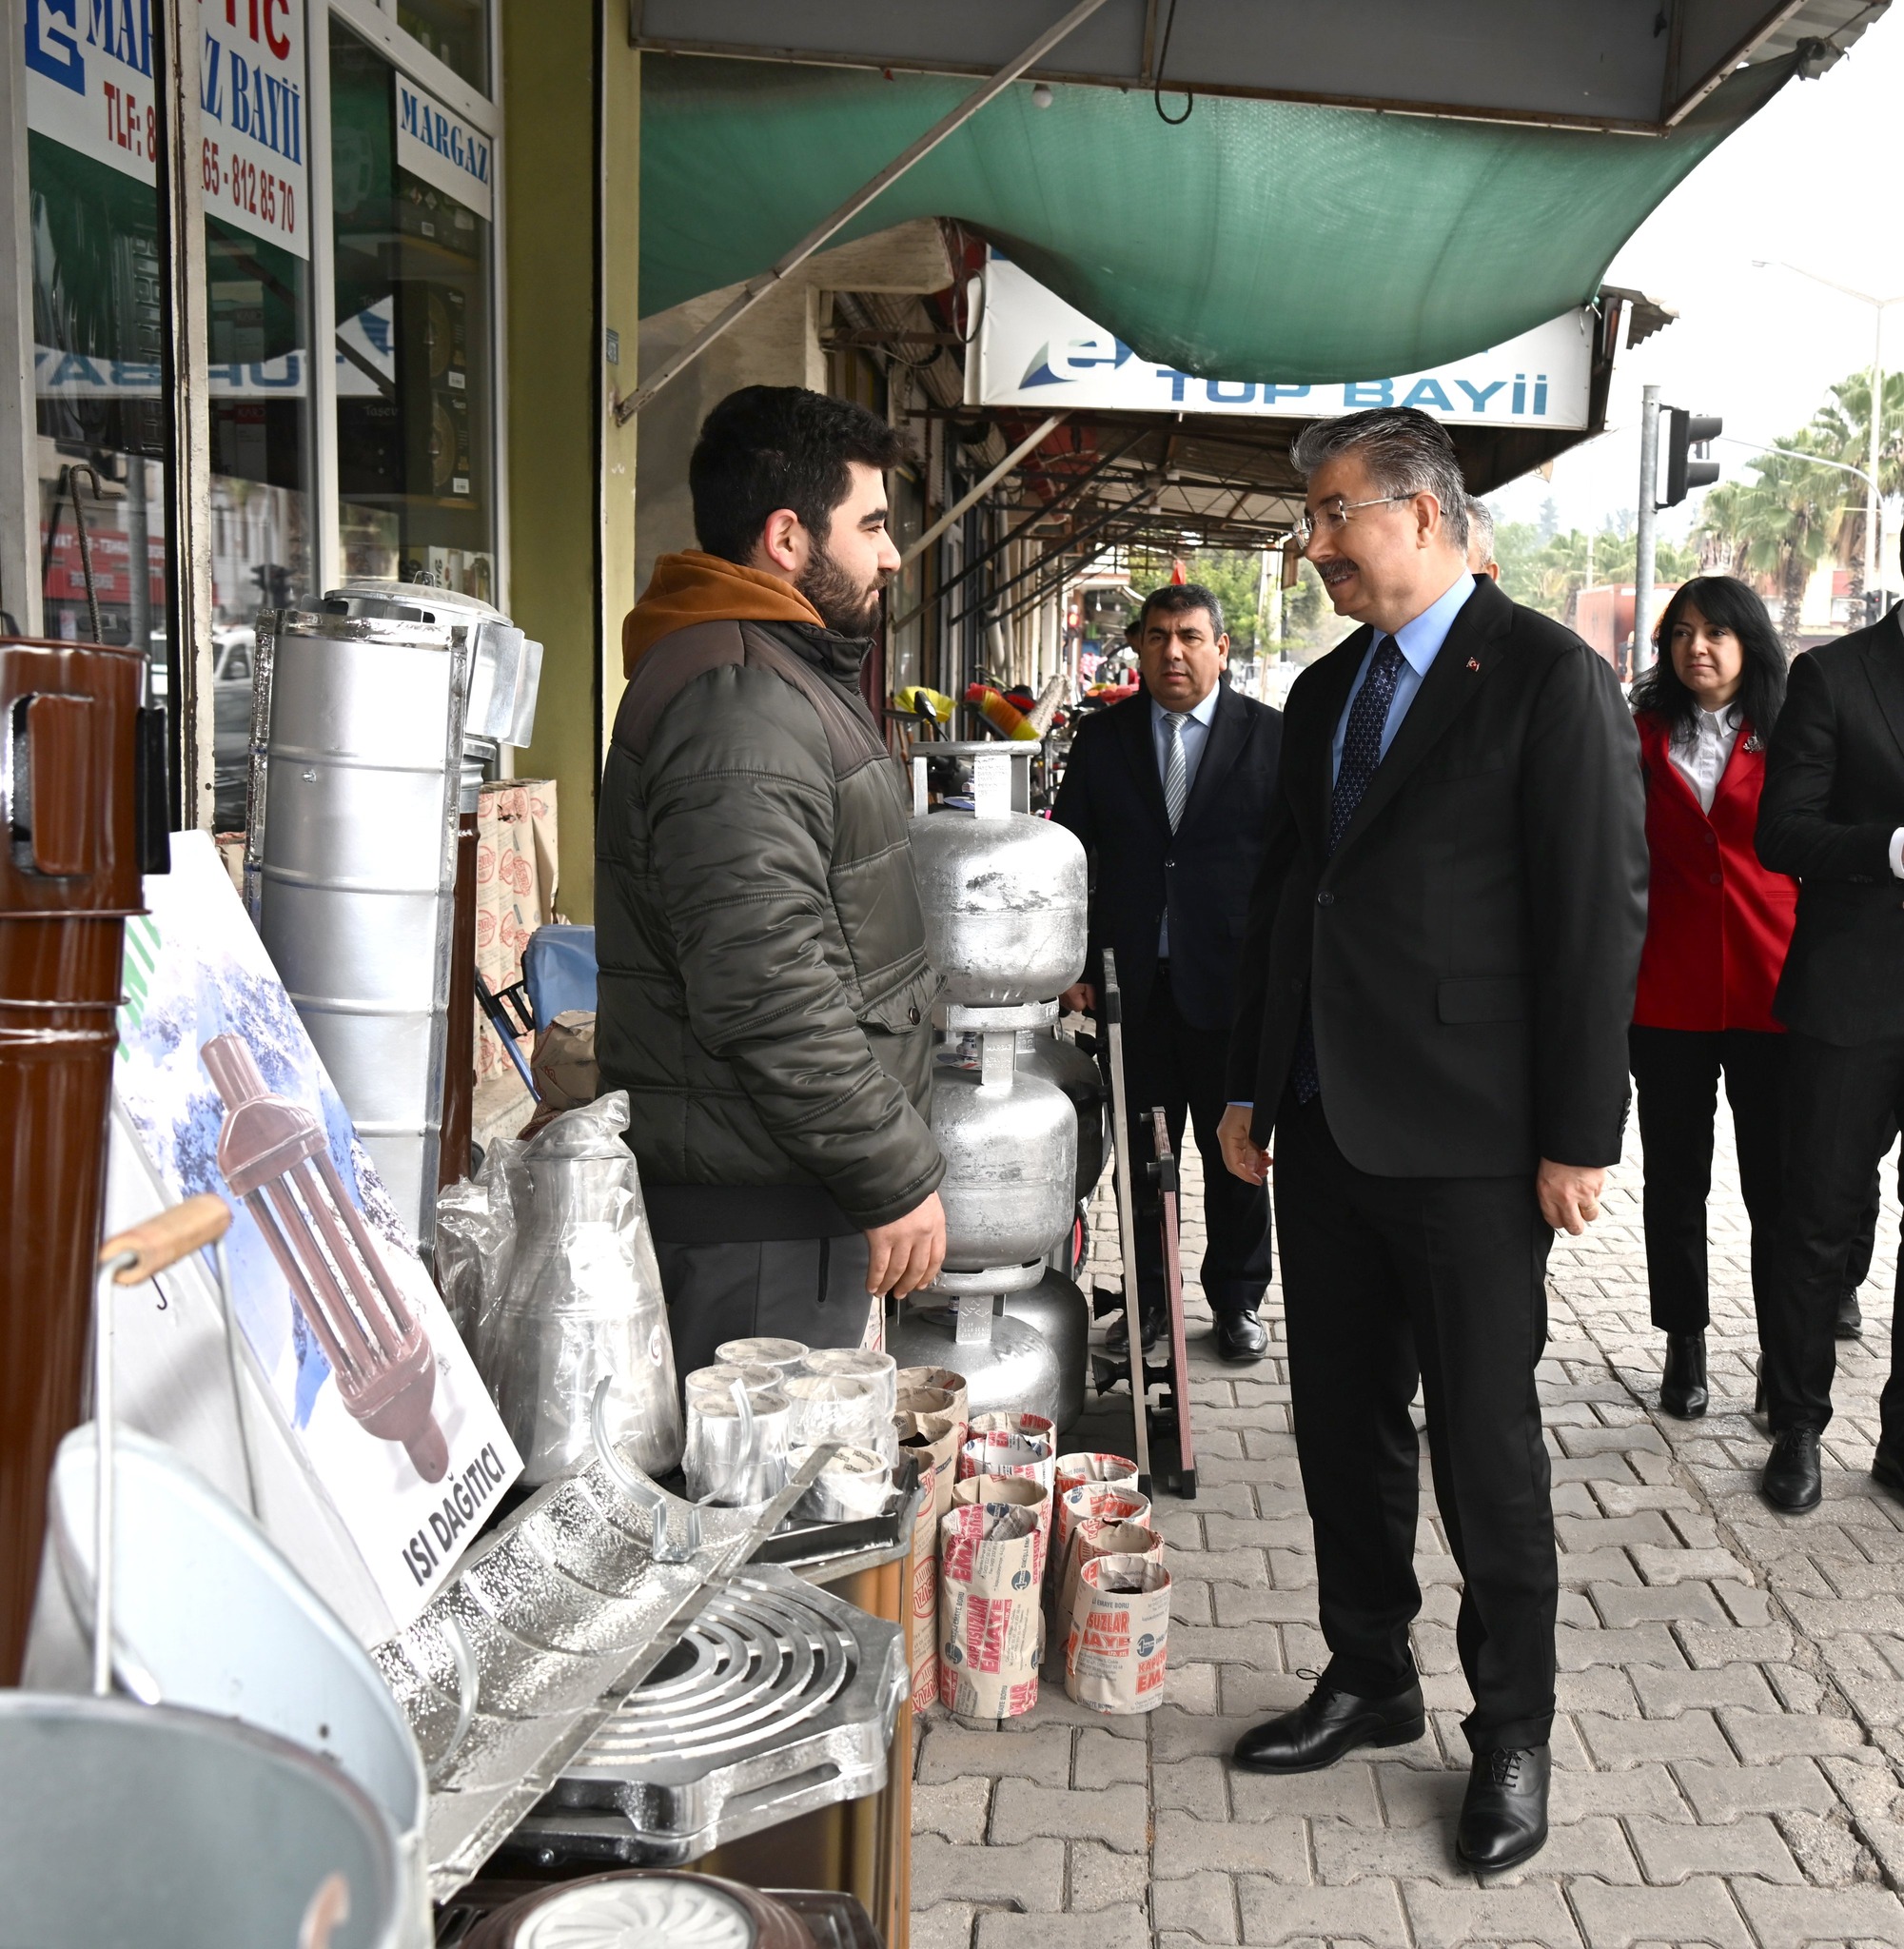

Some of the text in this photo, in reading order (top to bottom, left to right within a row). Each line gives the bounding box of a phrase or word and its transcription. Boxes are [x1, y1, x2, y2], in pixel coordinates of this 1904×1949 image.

[400, 87, 488, 186] MARGAZ
[232, 153, 257, 215] 812
[402, 1442, 506, 1587] ISI DAĞITICI
[979, 1599, 1004, 1675] EMAYE
